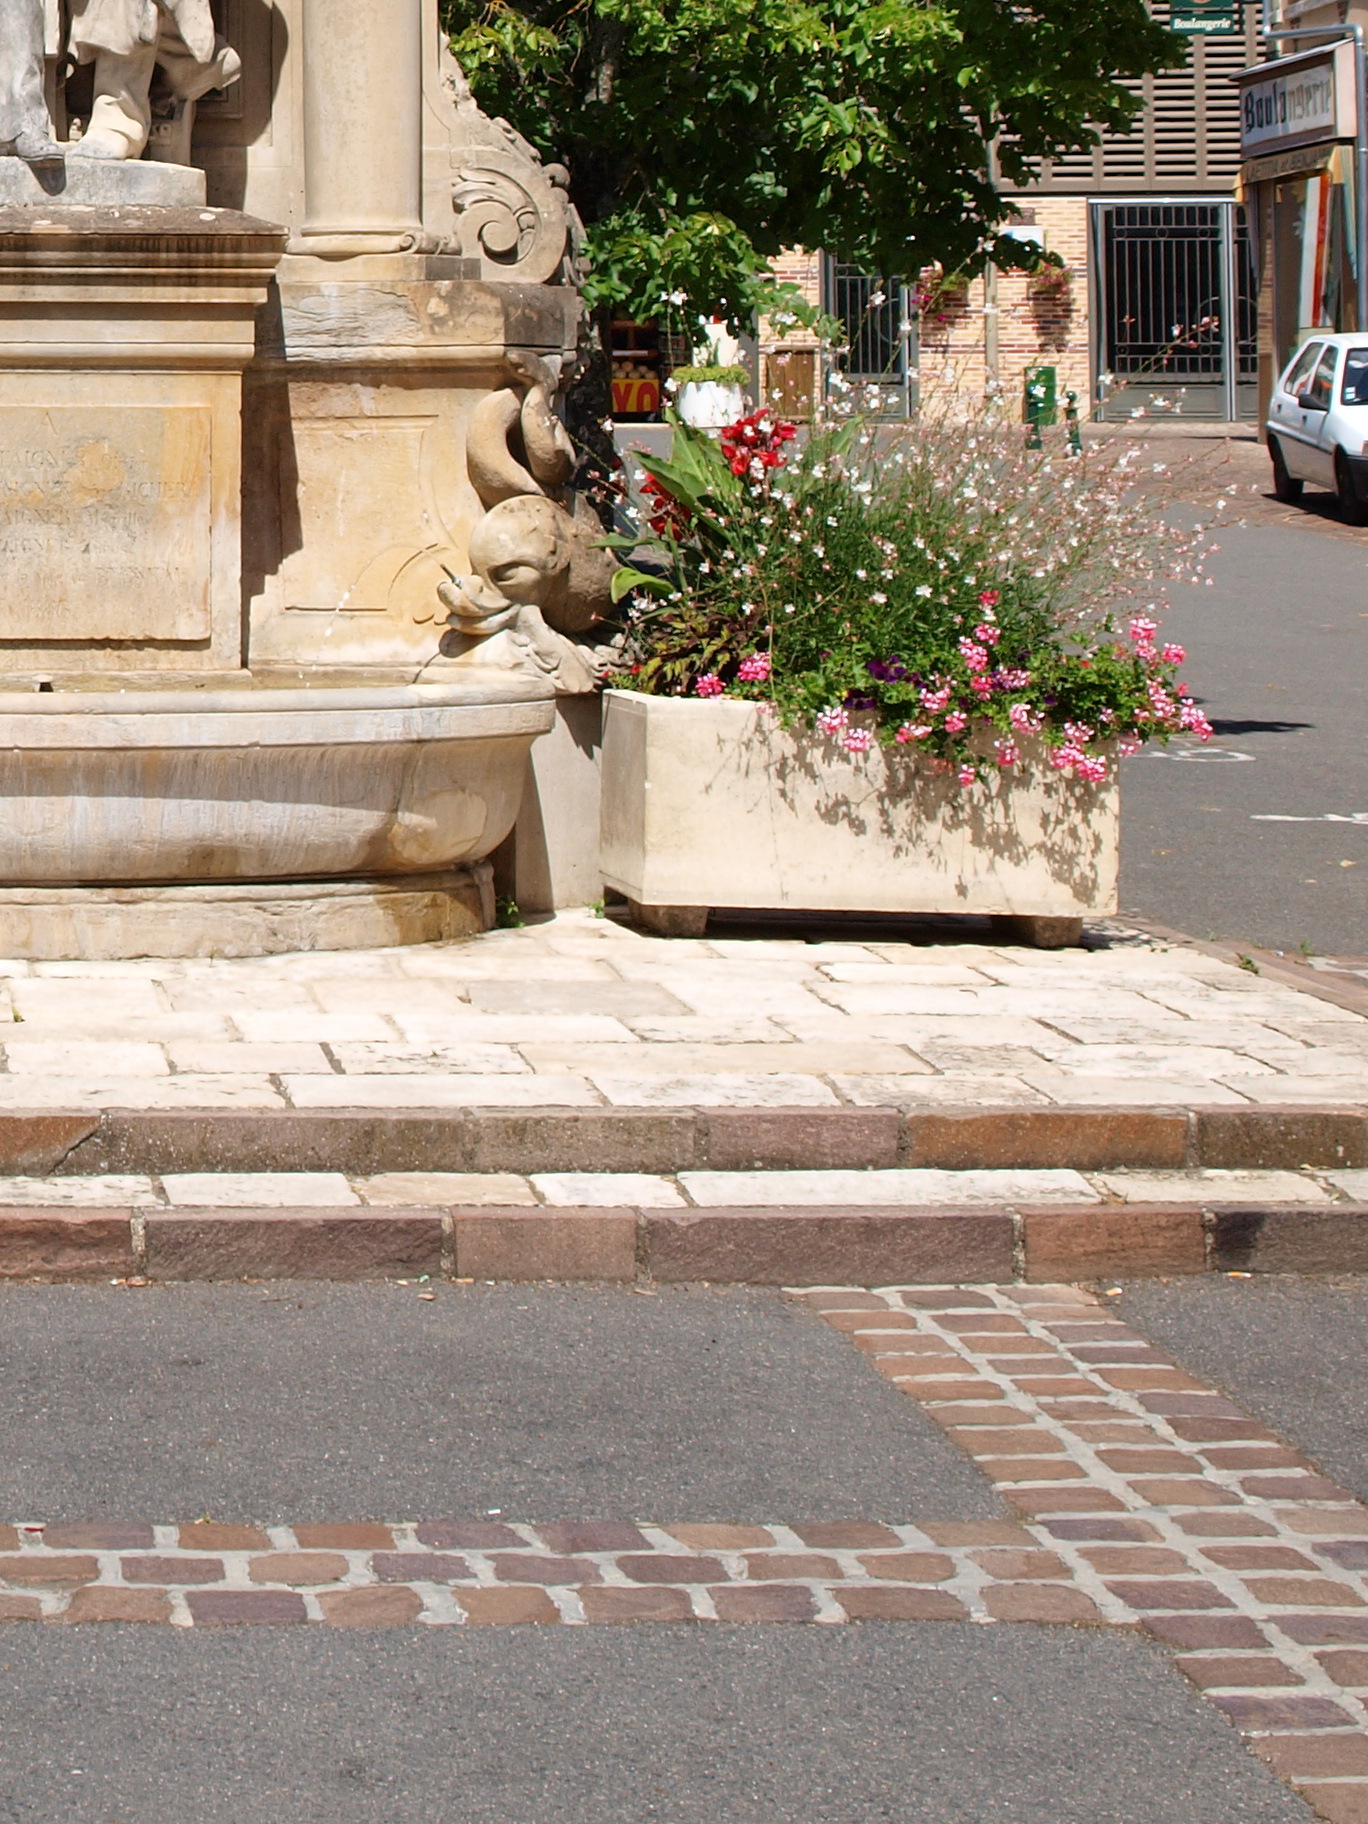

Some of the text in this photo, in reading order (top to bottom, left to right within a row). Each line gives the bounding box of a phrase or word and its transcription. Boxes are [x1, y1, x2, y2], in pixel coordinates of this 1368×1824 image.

[1173, 17, 1232, 31] Boulangerie
[1243, 78, 1332, 134] Boulangerie
[40, 412, 59, 435] A
